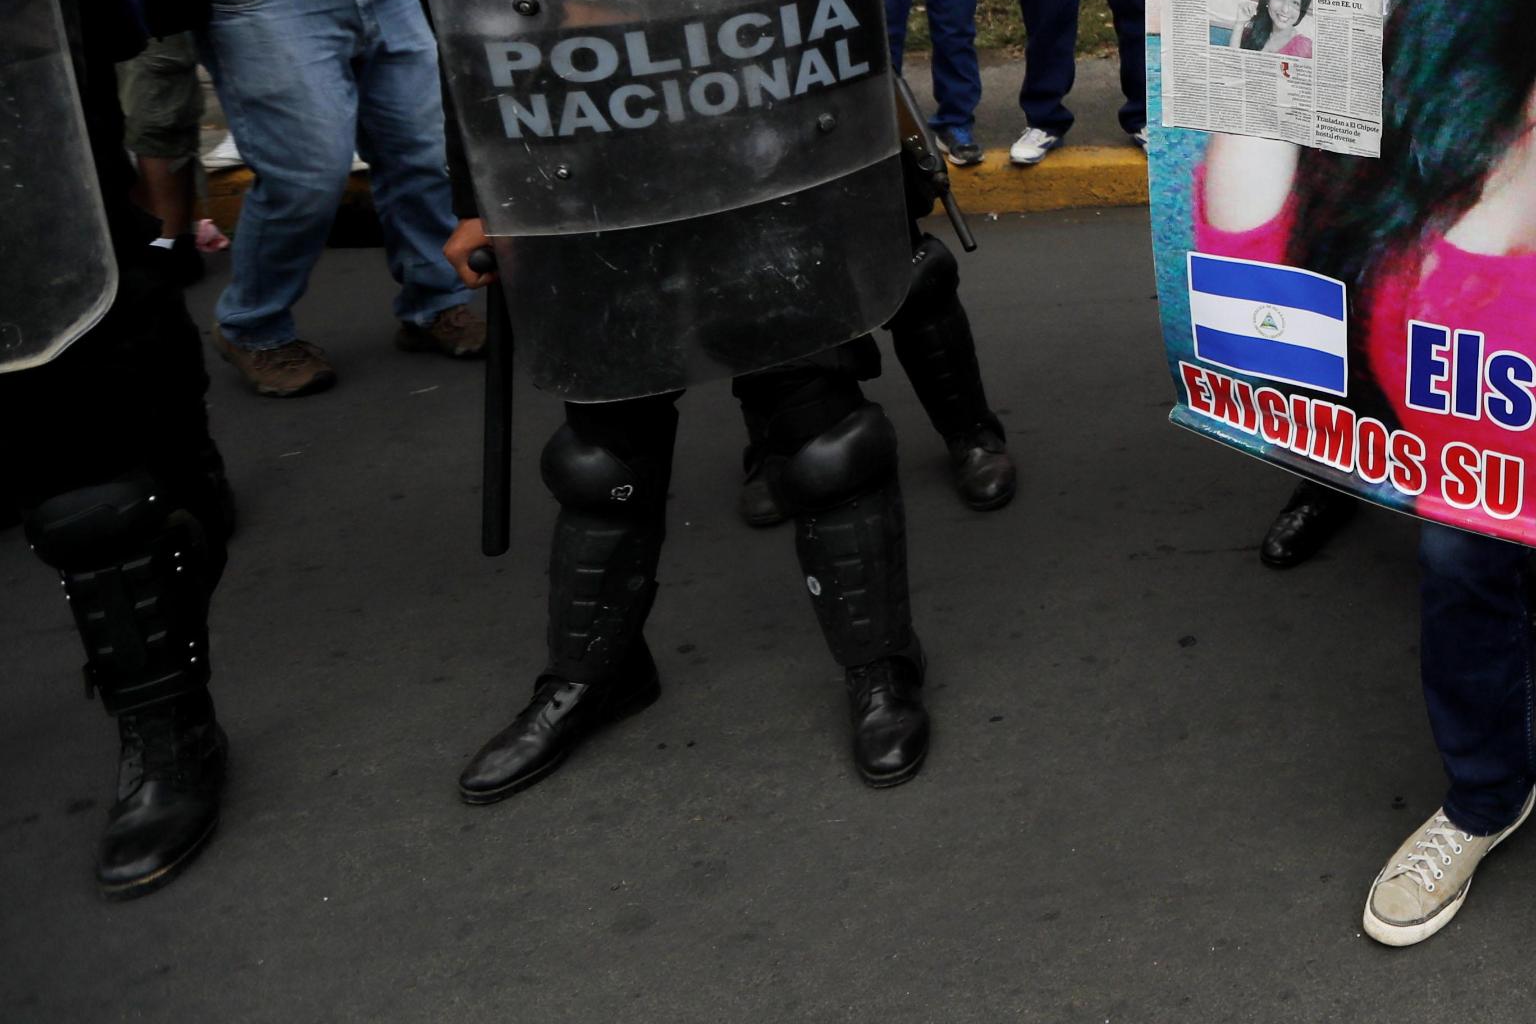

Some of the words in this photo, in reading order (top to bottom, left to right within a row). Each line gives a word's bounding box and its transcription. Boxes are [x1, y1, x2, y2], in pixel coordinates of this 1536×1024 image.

[498, 38, 871, 139] NACIONAL
[1316, 115, 1345, 127] Trasladan
[1356, 123, 1380, 133] Chipote
[1320, 124, 1353, 136] propietario
[1315, 129, 1334, 139] hostal
[1178, 360, 1427, 496] EXIGIMOS
[1440, 441, 1525, 520] SU
